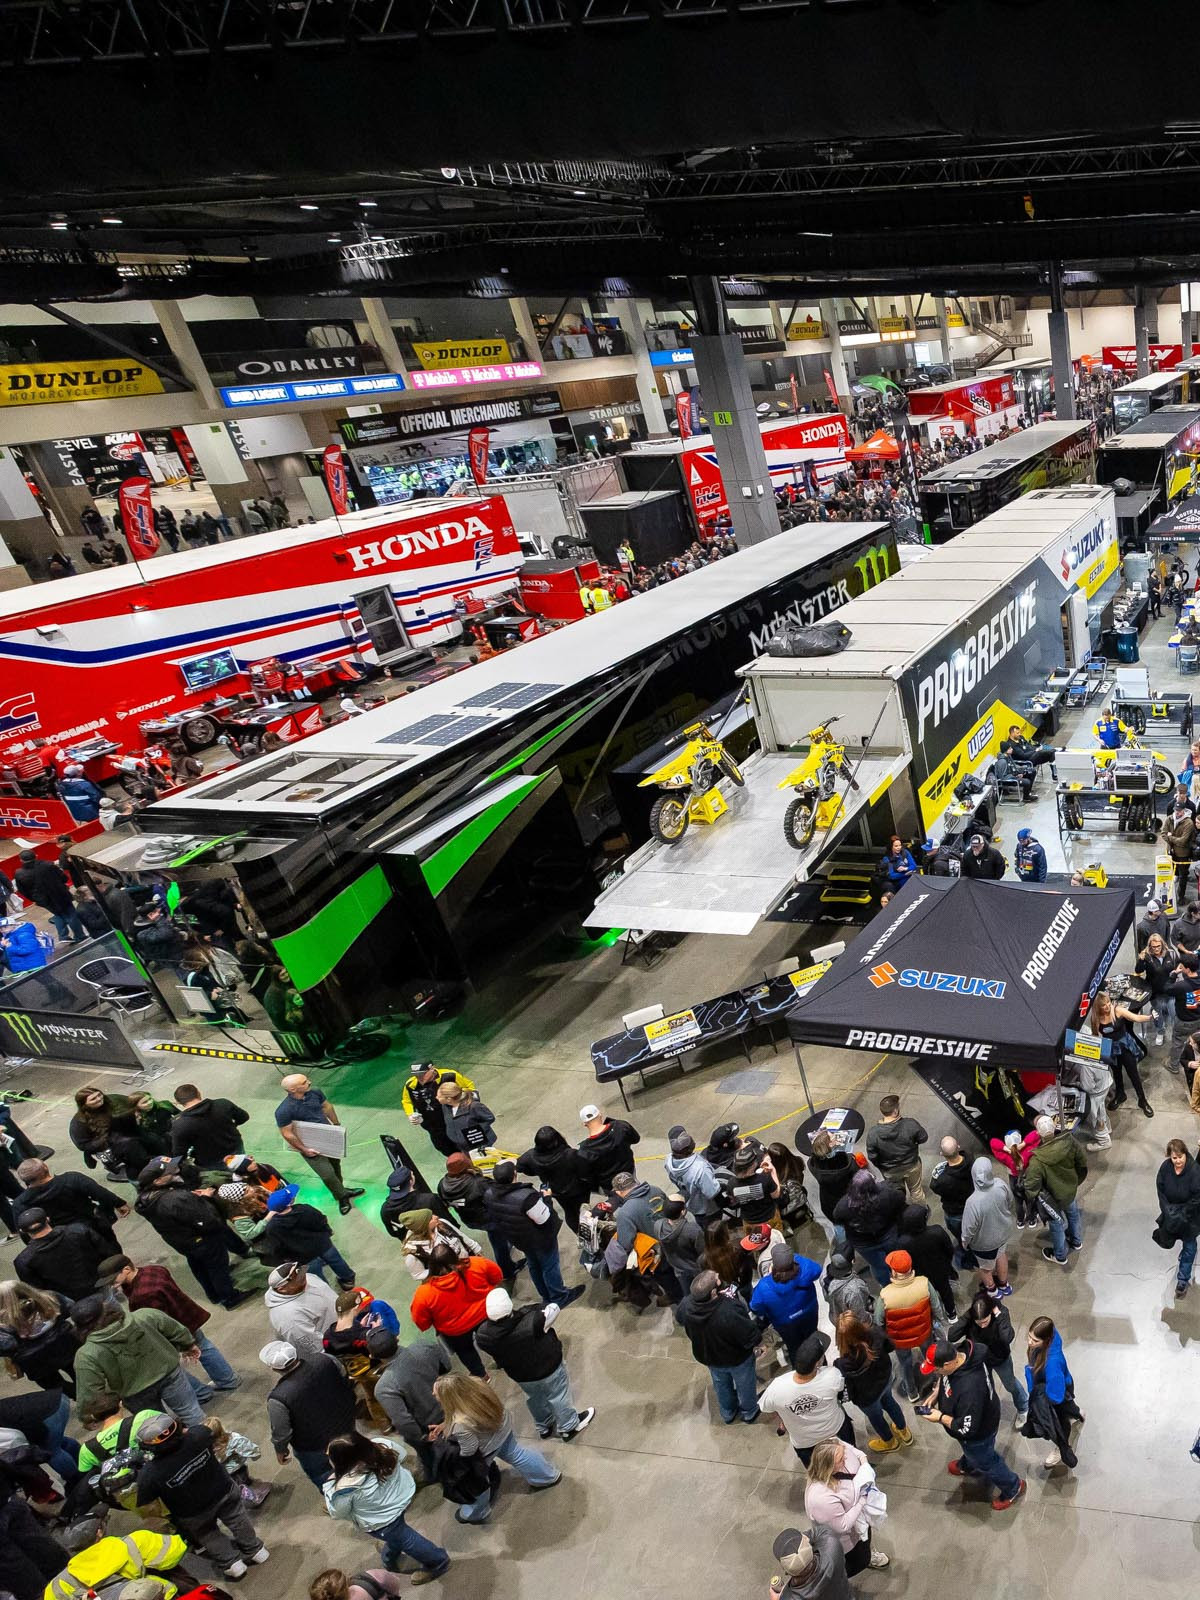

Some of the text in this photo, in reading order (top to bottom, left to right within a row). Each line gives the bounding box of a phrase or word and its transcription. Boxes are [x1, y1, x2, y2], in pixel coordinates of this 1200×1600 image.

[795, 323, 821, 335] DUNLOP
[438, 345, 502, 360] DUNLOP
[271, 356, 358, 374] OAKLEY
[8, 367, 143, 391] DUNLOP
[318, 382, 346, 396] LIGHT
[426, 373, 458, 386] Mobile
[10, 383, 140, 400] MOTORCYCLE TIRES
[254, 387, 287, 401] LIGHT
[969, 390, 992, 411] Beta
[400, 409, 449, 433] OFFICIAL
[451, 401, 521, 426] MERCHANDISE
[589, 404, 641, 420] STARBUCKS
[718, 412, 729, 425] 8L
[105, 434, 137, 446] KTM
[801, 421, 846, 445] HONDA
[232, 431, 253, 460] EAST
[58, 453, 86, 486] EAST
[347, 516, 493, 572] HONDA
[473, 536, 494, 572] CRF
[1071, 519, 1105, 571] SUZUKI
[520, 579, 550, 587] ONDA
[918, 578, 1038, 745] PROGRESSIVE
[129, 694, 176, 716] DUNLOP
[0, 724, 42, 741] ACING
[968, 714, 994, 761] WPS
[925, 754, 961, 800] FLY
[860, 893, 930, 966] PROGRESSIVE
[1021, 898, 1080, 990] PROGRESSIVE
[1088, 929, 1120, 999] SUZUKI
[898, 968, 1007, 999] SUZUKI
[37, 1023, 108, 1041] MONSTER
[55, 1036, 103, 1047] ENERGY
[664, 1043, 697, 1059] SUZUKI
[846, 1030, 993, 1061] PROGRESSIVE
[930, 1079, 952, 1103] MATRIX
[789, 1401, 818, 1414] VANS
